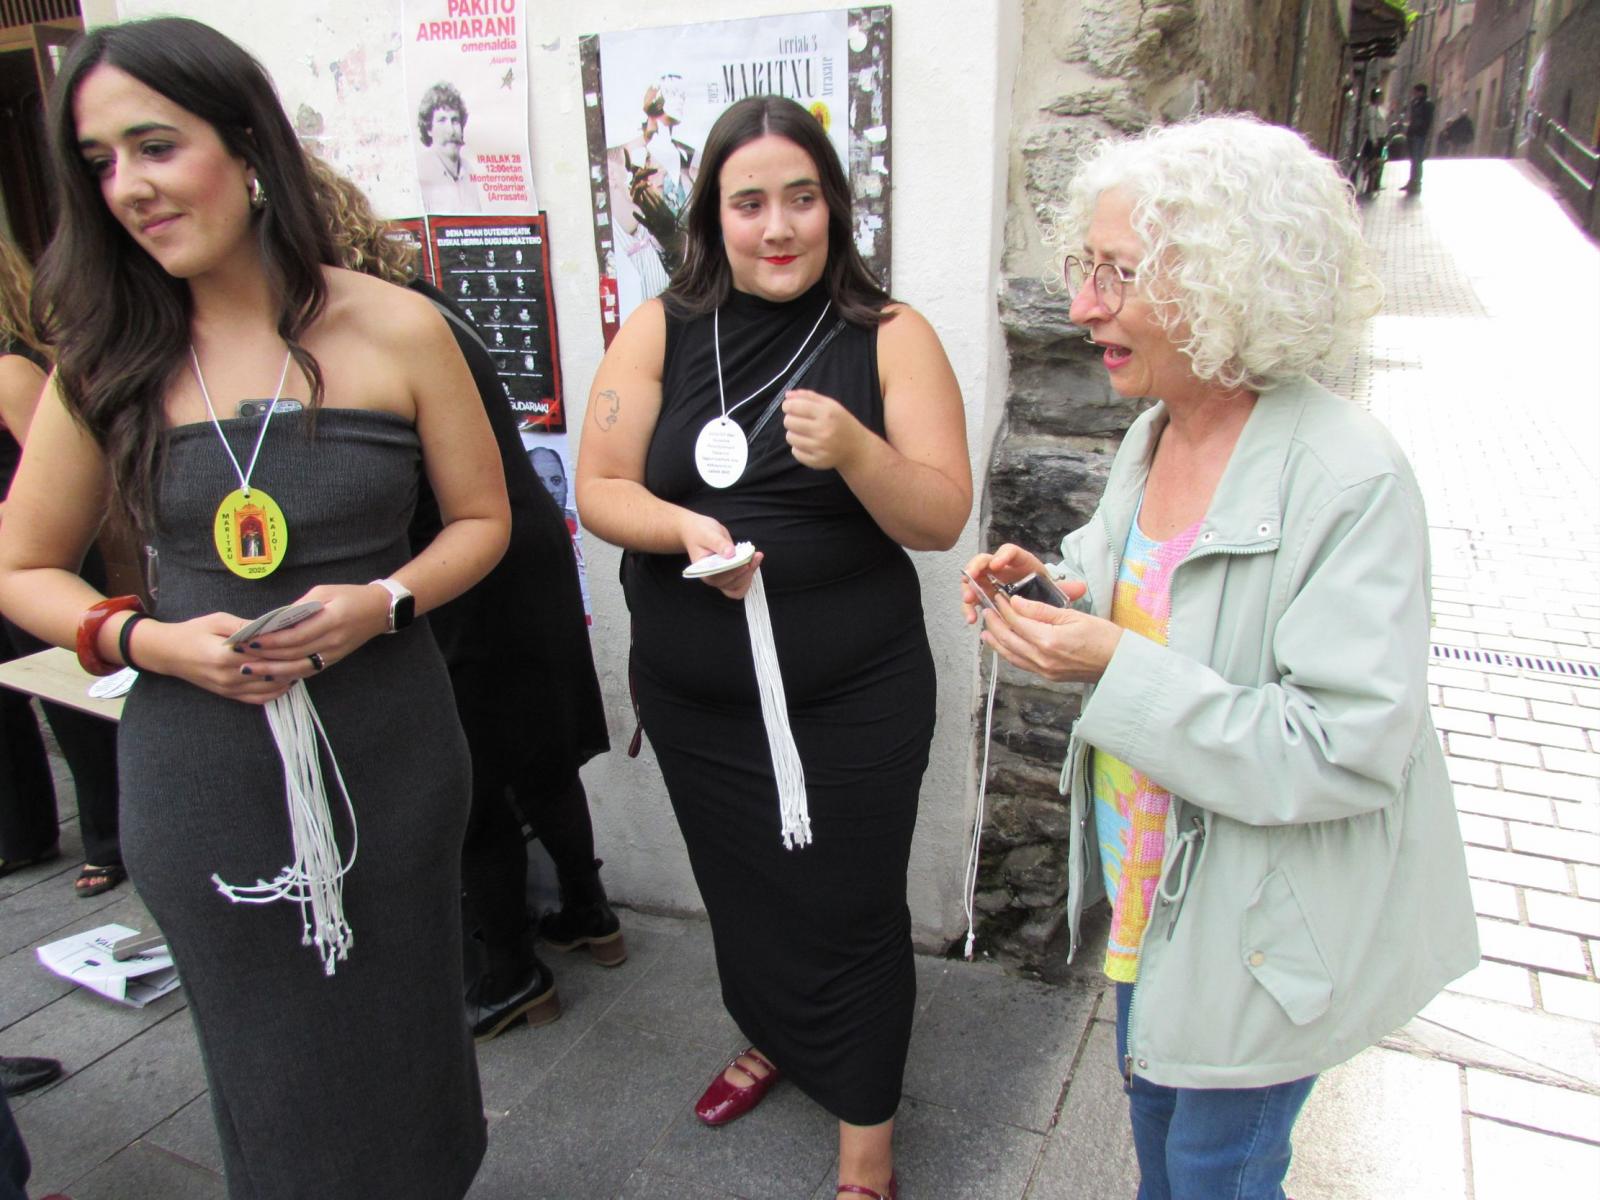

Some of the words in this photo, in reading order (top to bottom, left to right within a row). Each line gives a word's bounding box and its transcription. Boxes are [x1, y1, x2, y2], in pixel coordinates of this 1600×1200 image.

[448, 0, 515, 18] PAKITO
[416, 16, 516, 42] ARRIARANI
[461, 38, 517, 53] omenaldia
[811, 34, 818, 52] 3
[722, 58, 816, 103] MARITXU
[477, 154, 510, 163] IRAILAK
[511, 153, 521, 163] 28
[486, 164, 522, 173] 12:00etan
[469, 174, 524, 183] Monterroneko
[488, 192, 528, 202] (Arrasate)
[445, 228, 463, 237] DENA
[464, 228, 483, 237] EMAN
[437, 238, 460, 246] EUSKAL
[460, 238, 484, 246] HERRIA
[484, 237, 501, 245] DUGU
[502, 236, 542, 245] IRABAZTEKO
[222, 513, 233, 559] MARITXU
[269, 517, 277, 551] KAJOI
